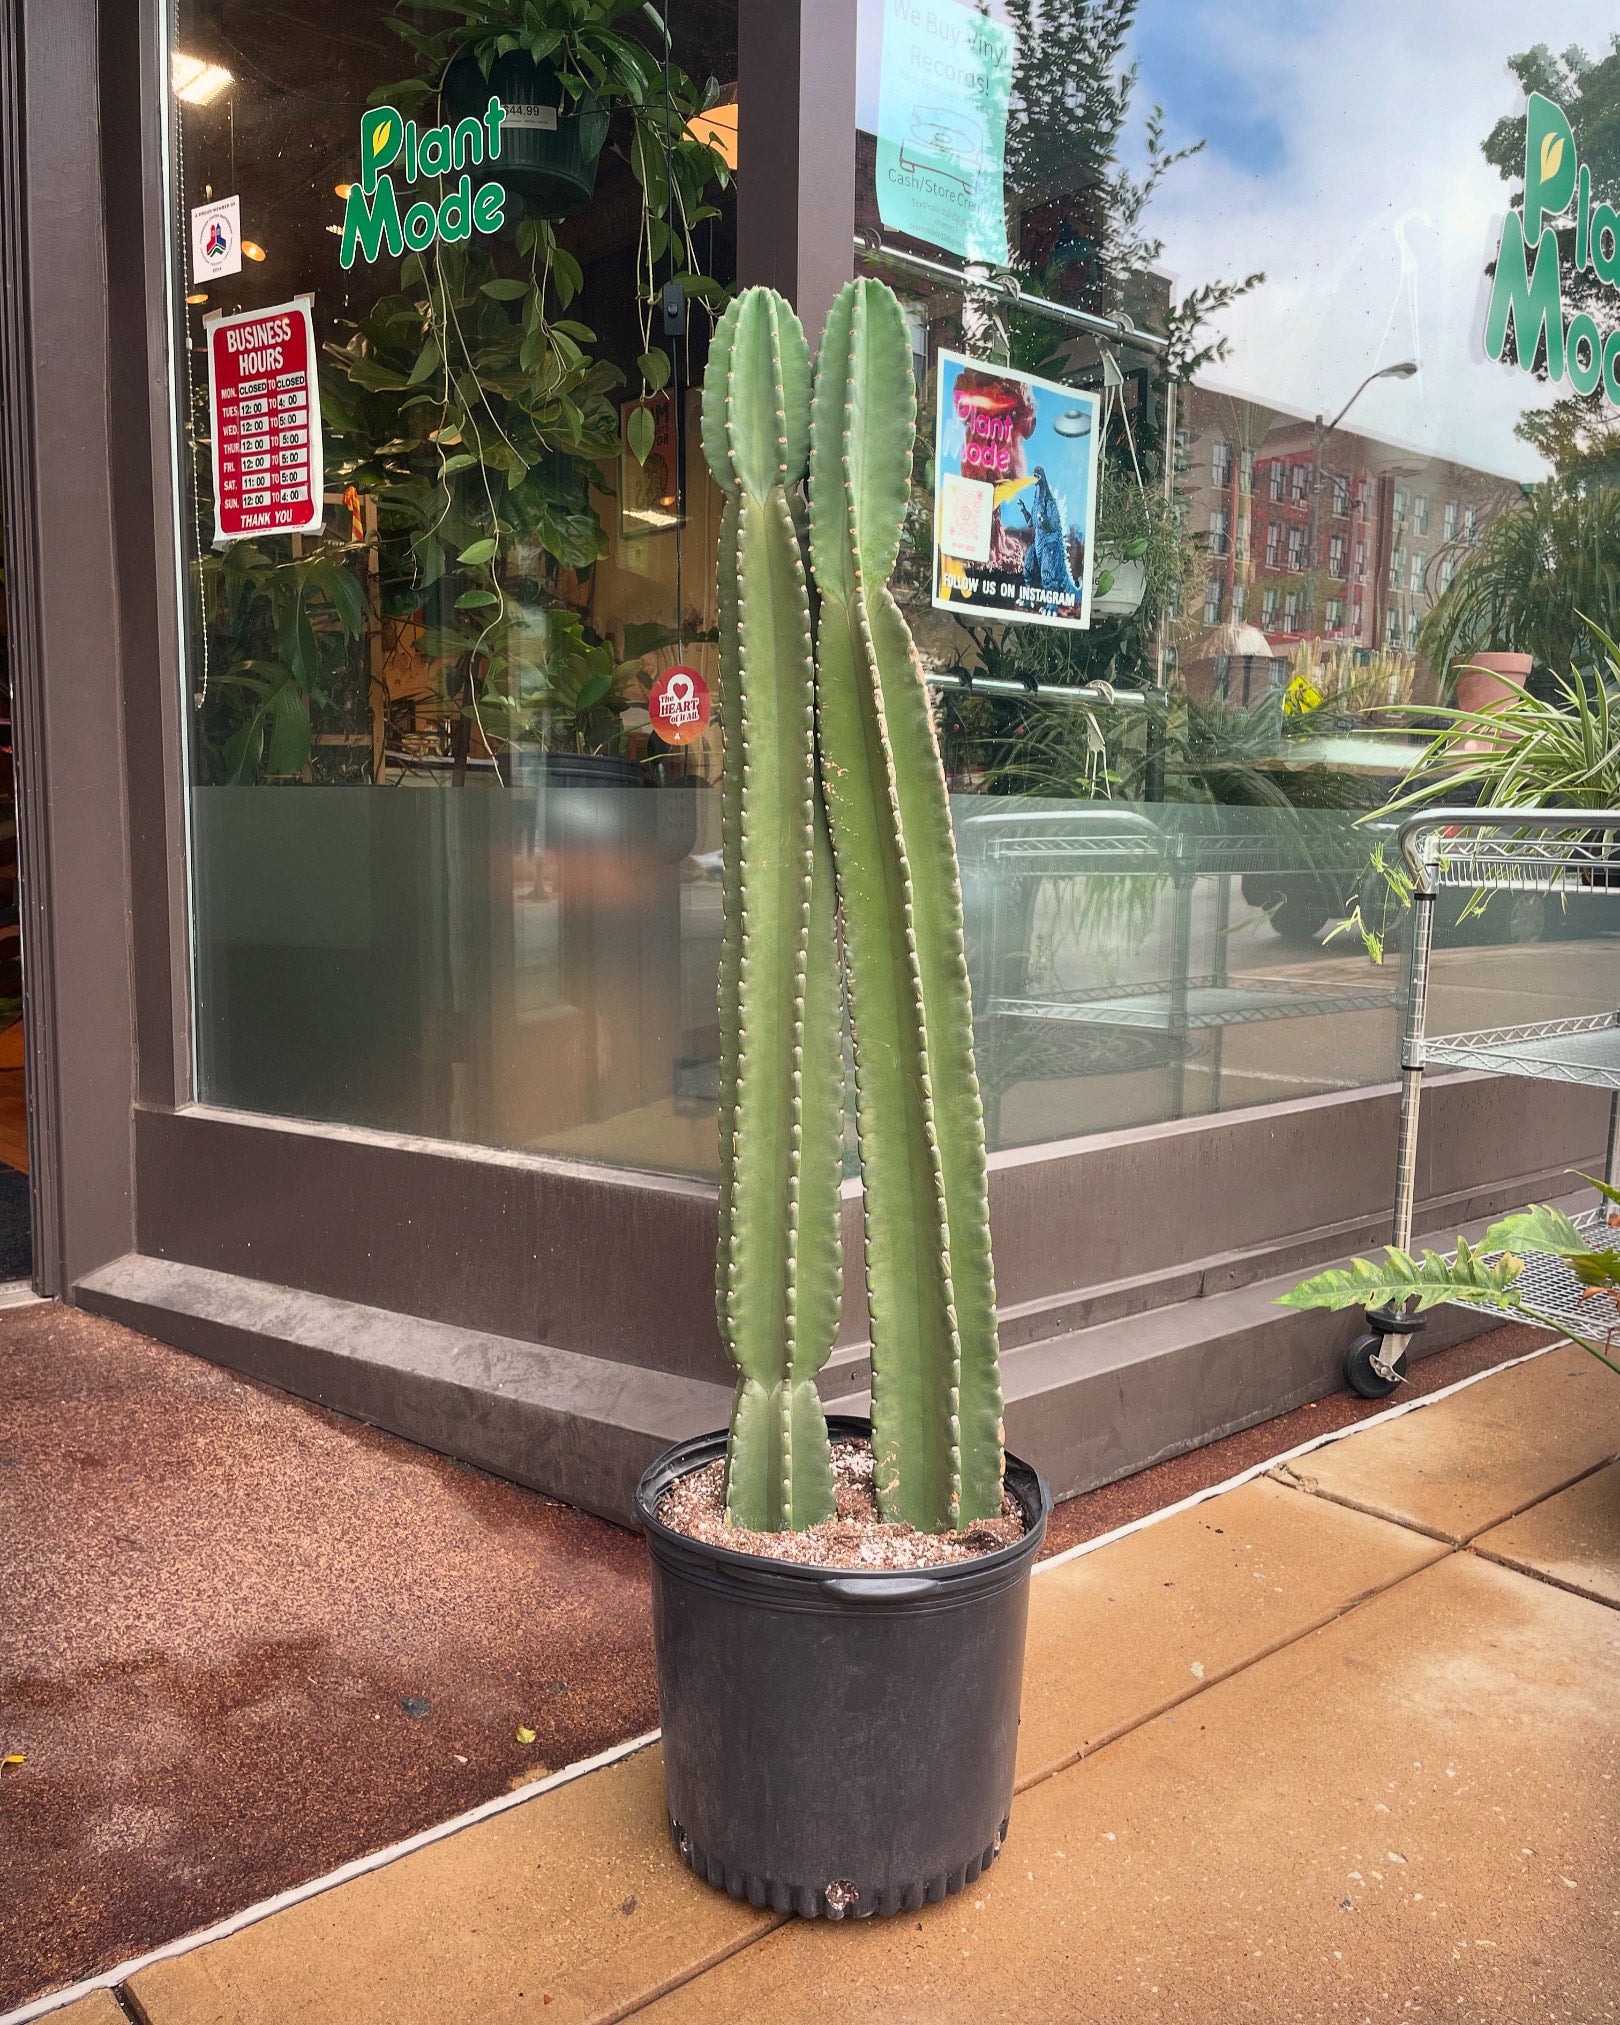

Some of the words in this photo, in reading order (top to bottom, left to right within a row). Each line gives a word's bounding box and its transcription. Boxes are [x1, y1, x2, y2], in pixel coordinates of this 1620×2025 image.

[894, 0, 921, 26] We
[927, 11, 961, 49] Buy
[911, 45, 990, 97] Records!
[503, 104, 540, 117] $44.99
[361, 96, 506, 196] Plant
[339, 174, 506, 269] Mode
[226, 317, 292, 353] BUSINESS
[239, 346, 284, 377] HOURS
[239, 382, 267, 396] CLOSED
[268, 379, 276, 391] TO
[277, 375, 305, 389] CLOSED
[269, 398, 277, 409] TO
[223, 424, 239, 436] WED.
[270, 416, 279, 428] TO
[271, 435, 279, 447] TO
[224, 462, 236, 473] FRI.
[271, 455, 279, 466] TO
[224, 480, 238, 491] SAT.
[271, 473, 280, 484] TO
[224, 498, 240, 510] SUN.
[272, 492, 280, 503] TO
[241, 511, 271, 528] THANK
[274, 508, 293, 524] YOU
[944, 572, 979, 593] FOLLOW
[982, 580, 997, 595] US
[1000, 582, 1016, 599] ON
[1019, 585, 1076, 608] INSTAGRAM
[661, 700, 698, 716] HEART
